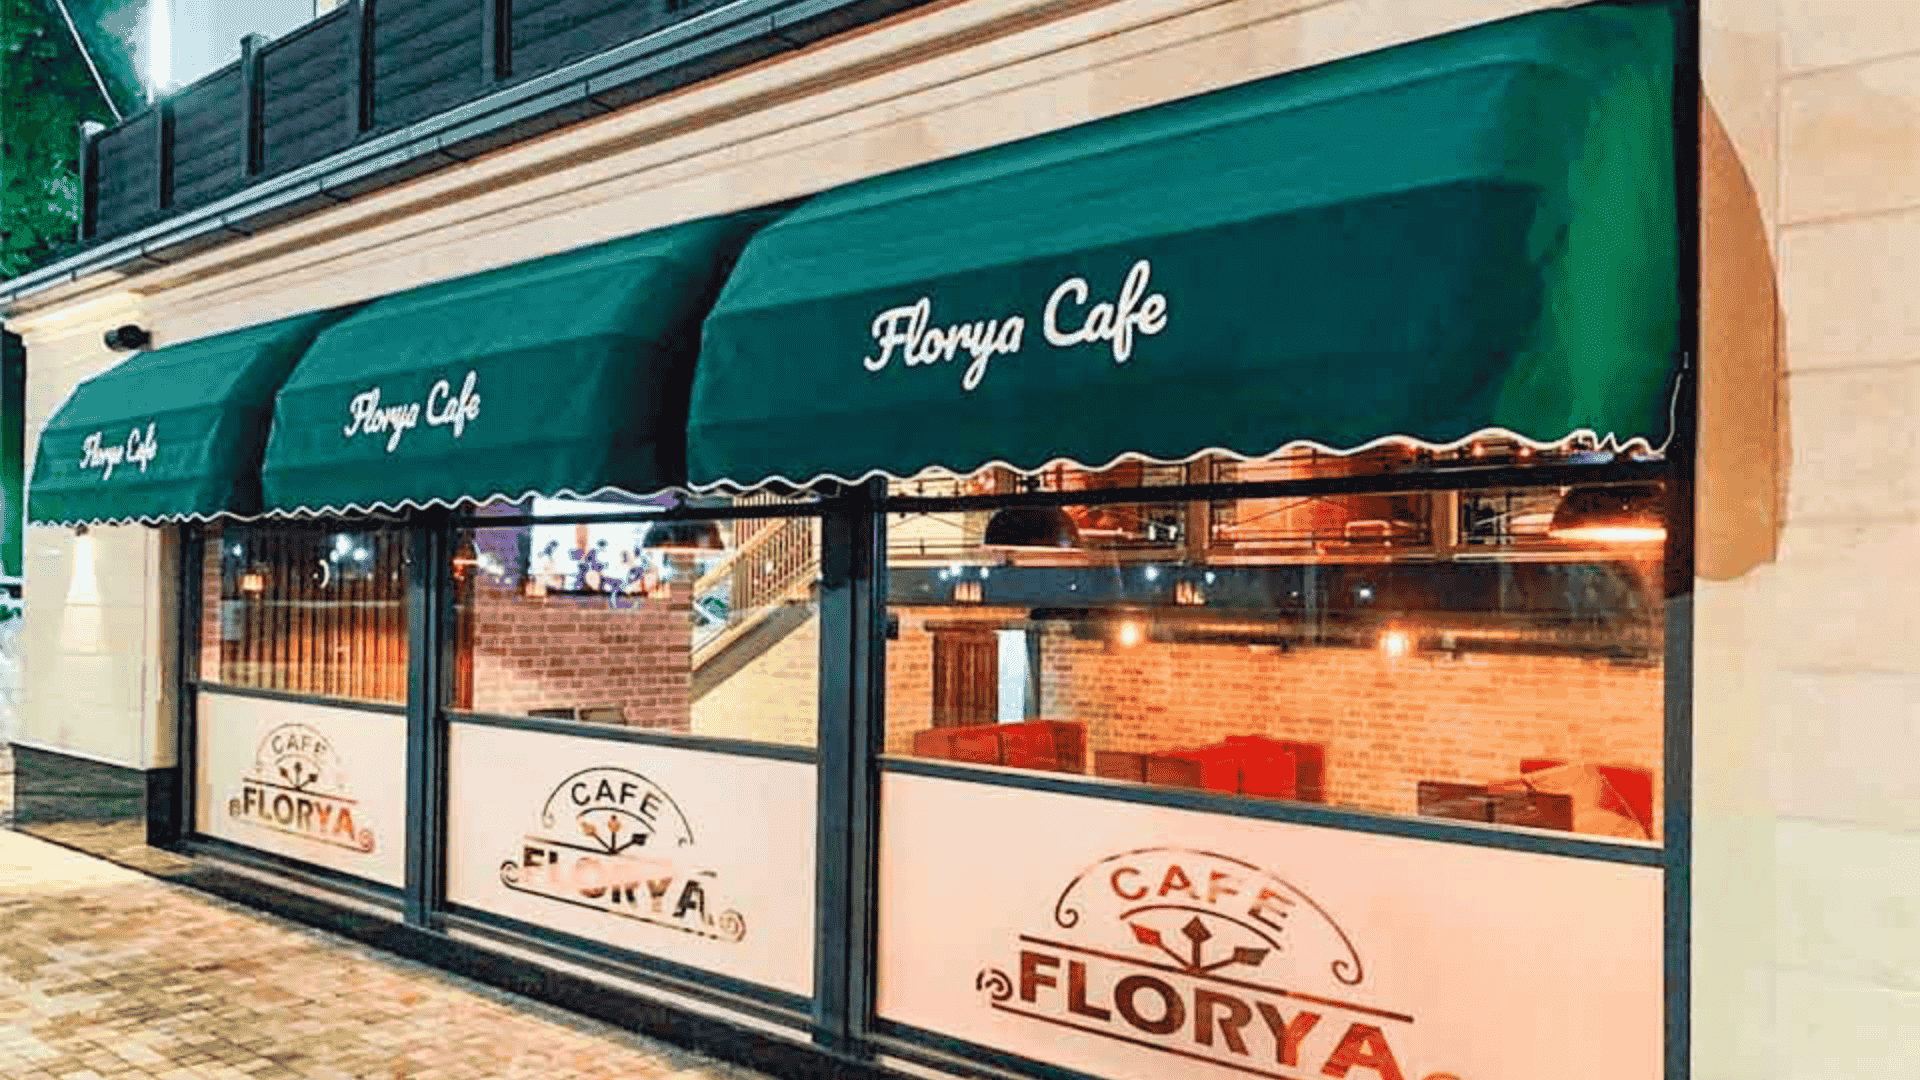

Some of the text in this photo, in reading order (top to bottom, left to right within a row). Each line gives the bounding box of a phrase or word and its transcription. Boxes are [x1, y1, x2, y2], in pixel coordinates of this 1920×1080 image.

[864, 259, 1168, 390] Florya Cafe
[344, 369, 481, 454] Florya Cafe
[243, 786, 356, 841] FLORYA
[571, 779, 663, 822] CAFE
[1110, 864, 1298, 933] CAFE
[1019, 949, 1405, 1080] FLORYA
